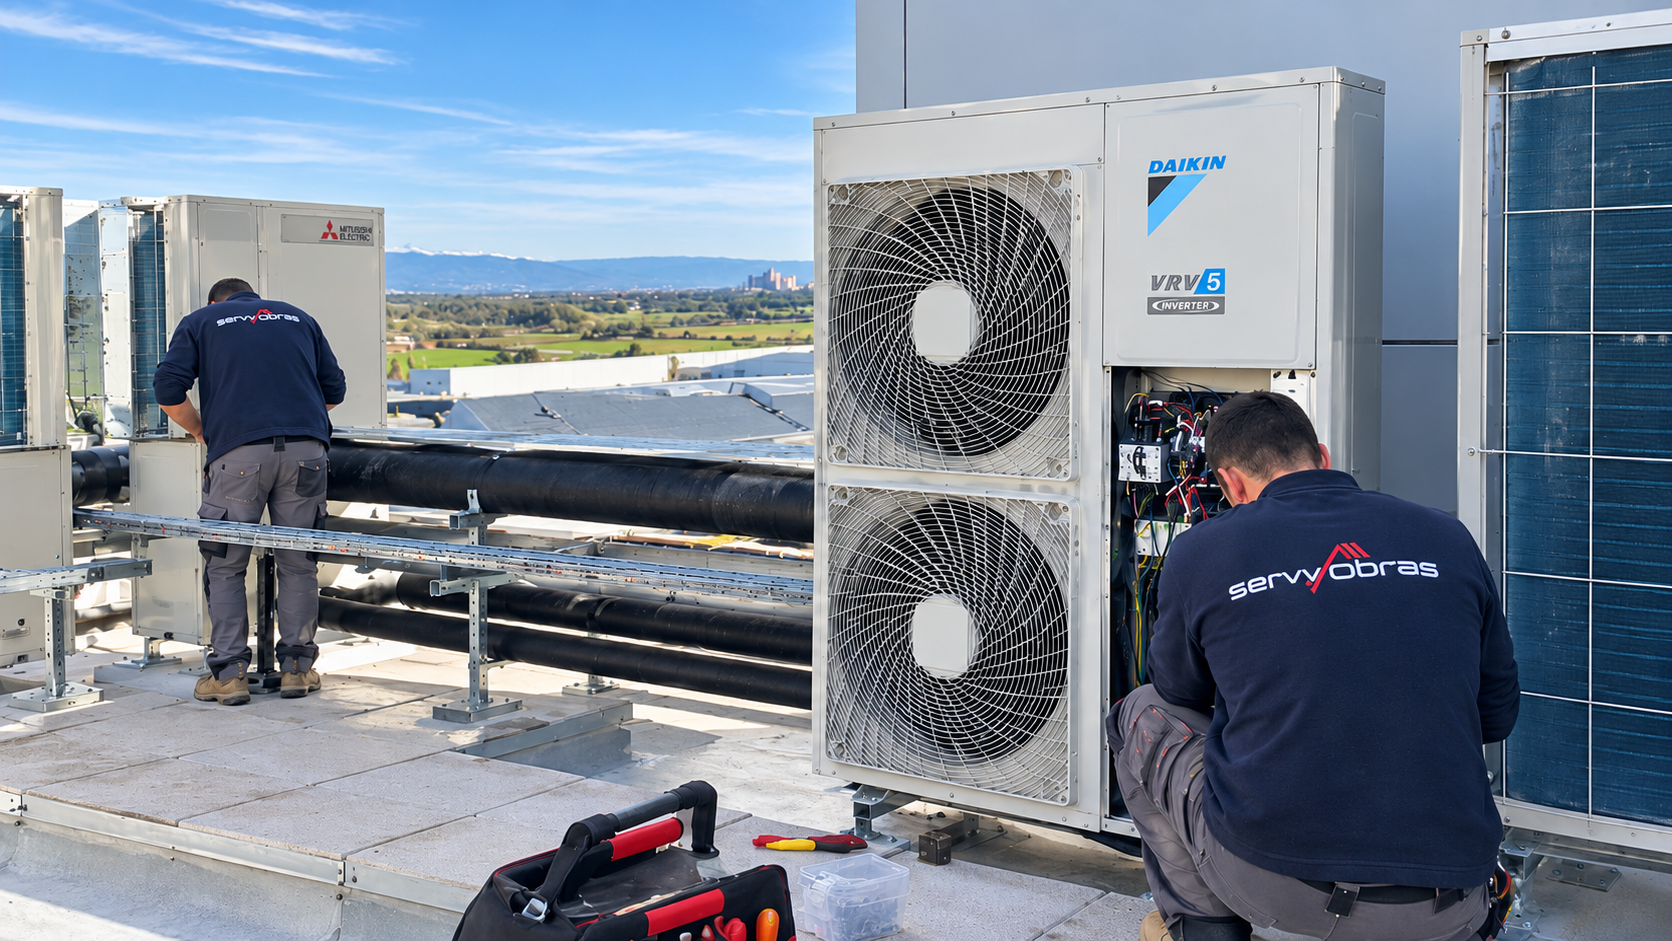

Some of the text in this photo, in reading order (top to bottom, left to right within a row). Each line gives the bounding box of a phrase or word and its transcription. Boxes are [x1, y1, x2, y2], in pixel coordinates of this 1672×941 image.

[1148, 155, 1227, 174] DAIKIN
[1151, 272, 1221, 291] VRV 5
[1161, 301, 1209, 311] INVERTER
